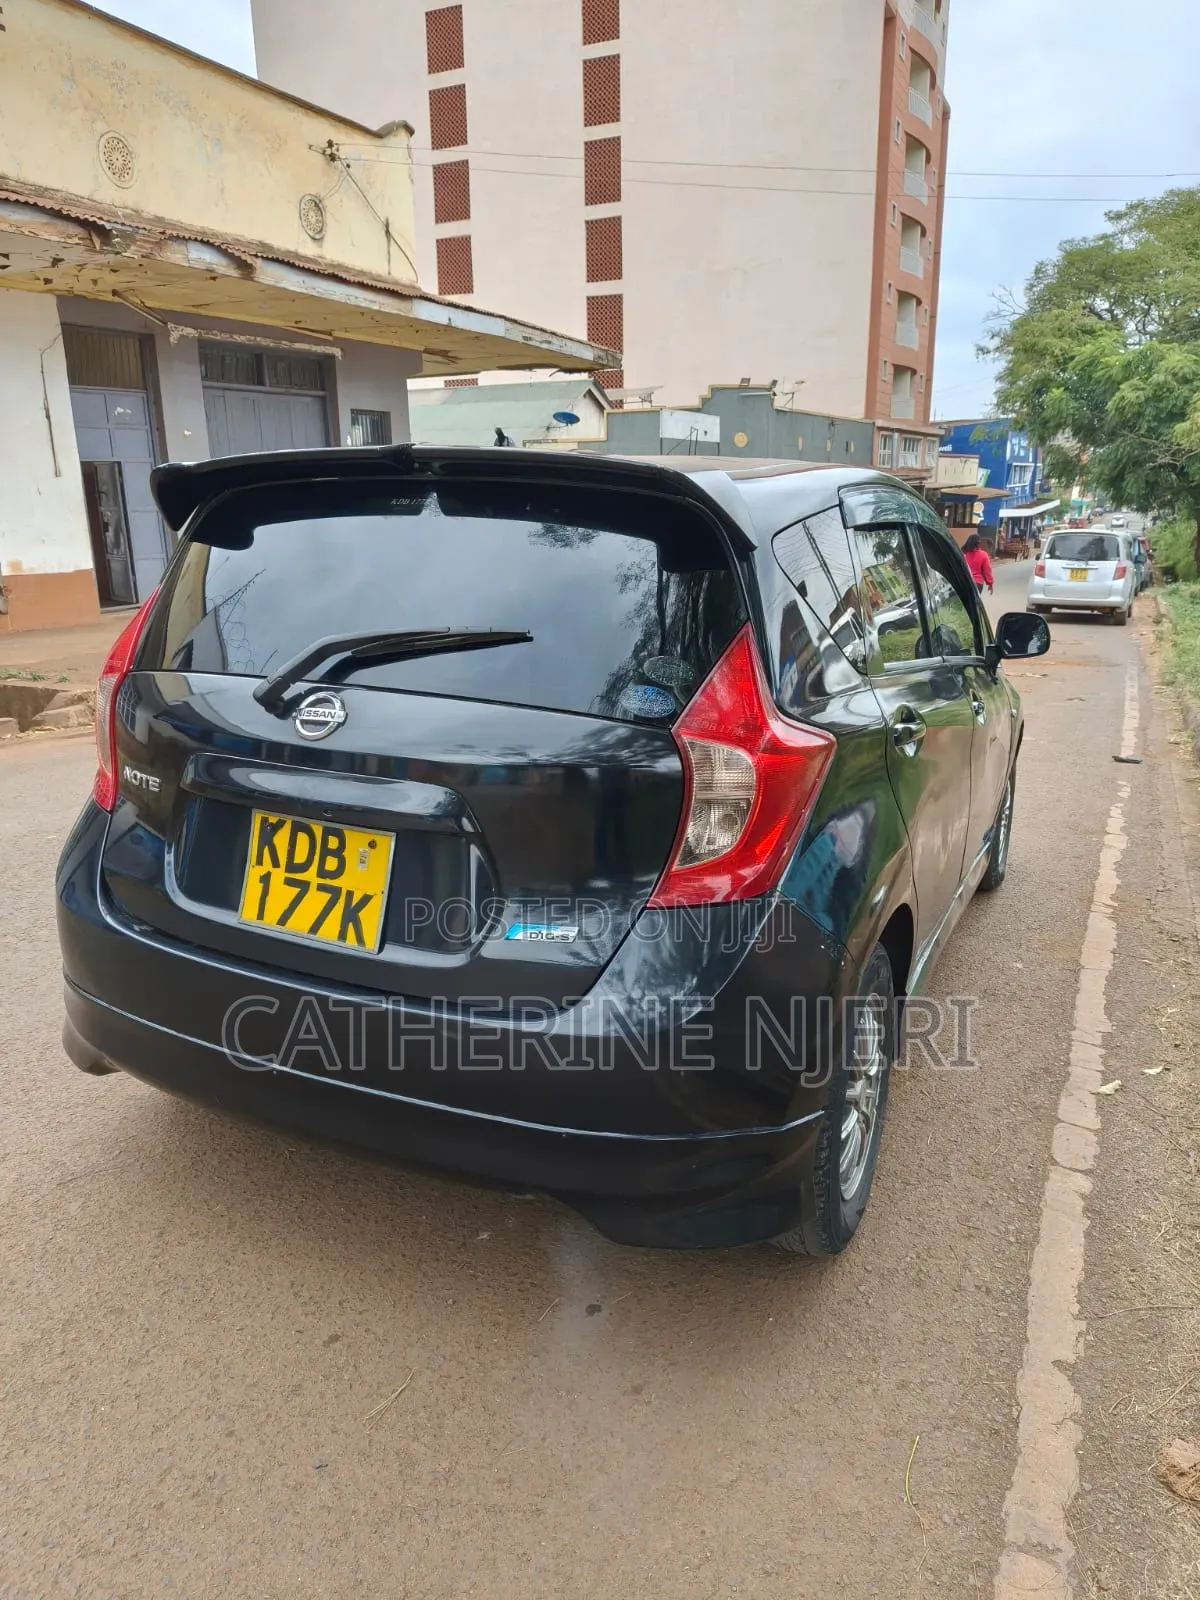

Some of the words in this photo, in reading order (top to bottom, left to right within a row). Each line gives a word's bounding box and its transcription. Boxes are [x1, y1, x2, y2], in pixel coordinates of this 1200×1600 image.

[296, 707, 338, 720] NISSAN
[122, 765, 161, 793] NOTE
[255, 816, 347, 880] KDB
[256, 870, 376, 948] 177K
[529, 931, 570, 941] DIG-S
